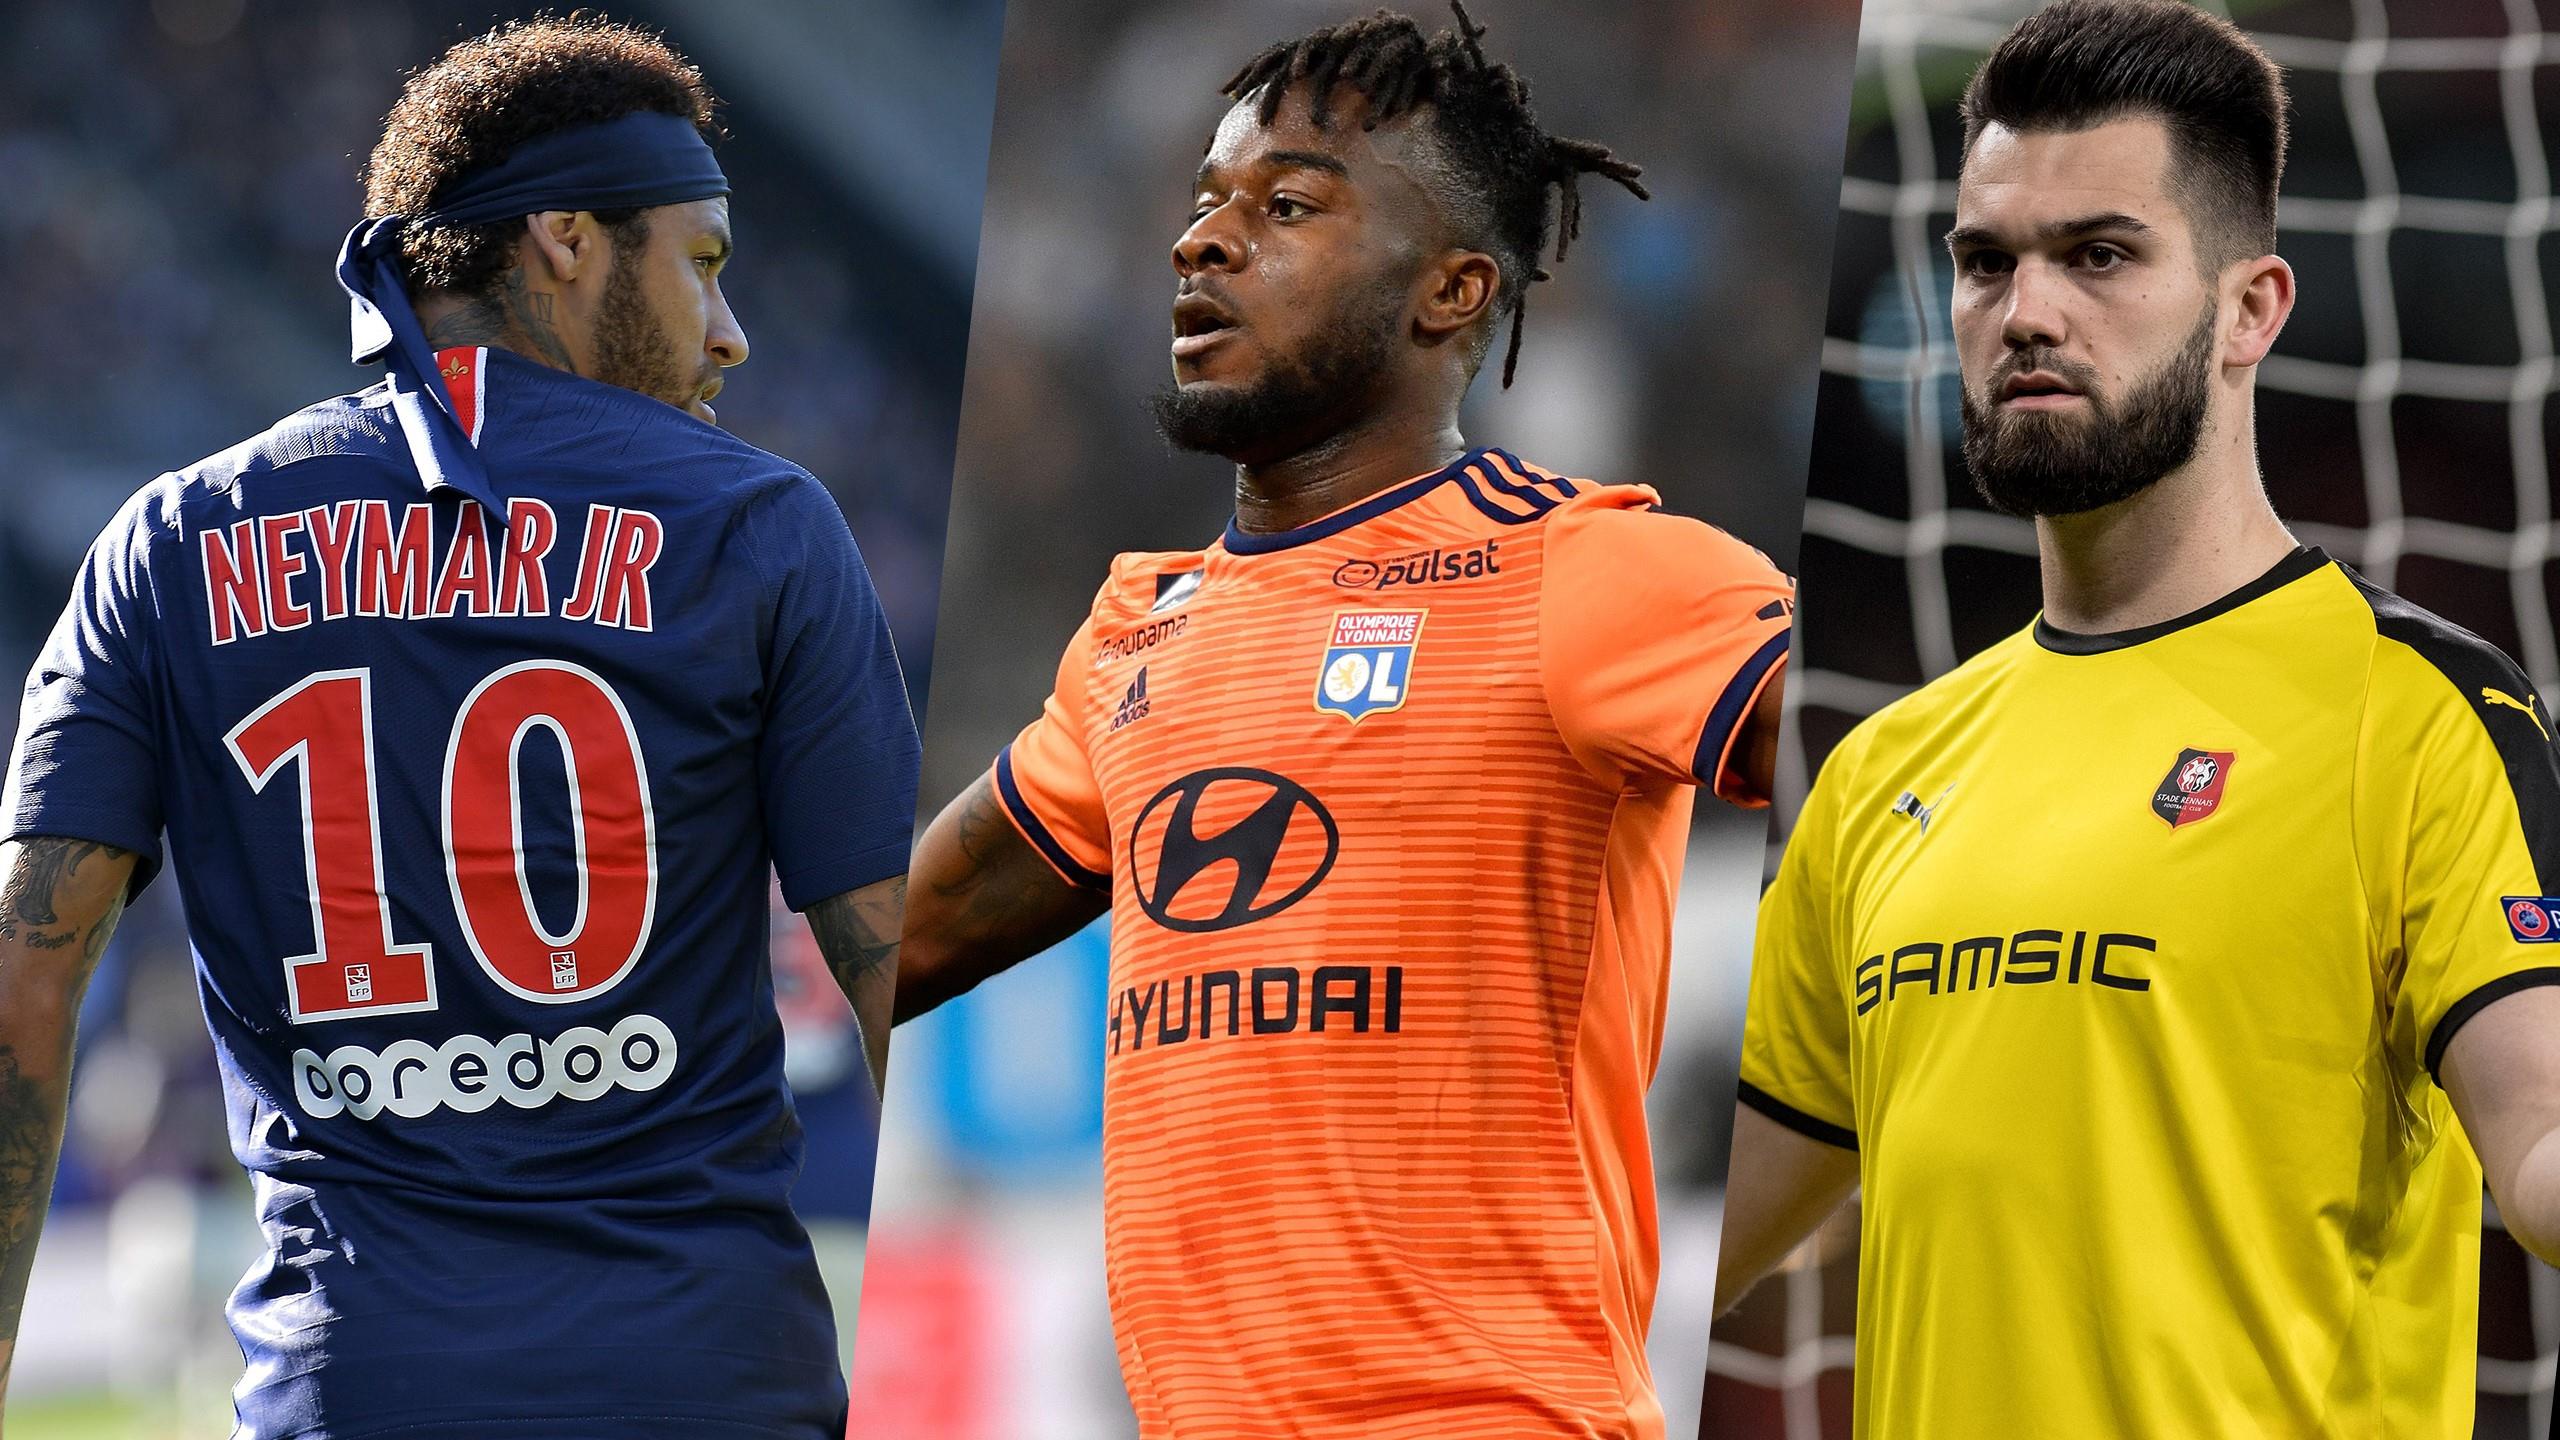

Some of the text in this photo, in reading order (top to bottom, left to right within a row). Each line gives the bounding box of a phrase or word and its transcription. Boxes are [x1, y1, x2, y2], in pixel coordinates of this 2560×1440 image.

[200, 498, 664, 646] NEYMAR JR
[1376, 539, 1500, 591] pulsat
[1335, 628, 1414, 644] LYONNAIS
[1338, 615, 1419, 630] OLYMPIQUE
[1110, 700, 1150, 732] adidas
[2156, 793, 2214, 807] STADE RENNAIS
[222, 659, 658, 1025] 10
[349, 987, 370, 998] LFP
[555, 974, 576, 985] LFP
[1855, 929, 2157, 1017] SAMSIC
[1108, 965, 1403, 1057] HYUNDAI
[302, 1028, 664, 1108] ooredoo
